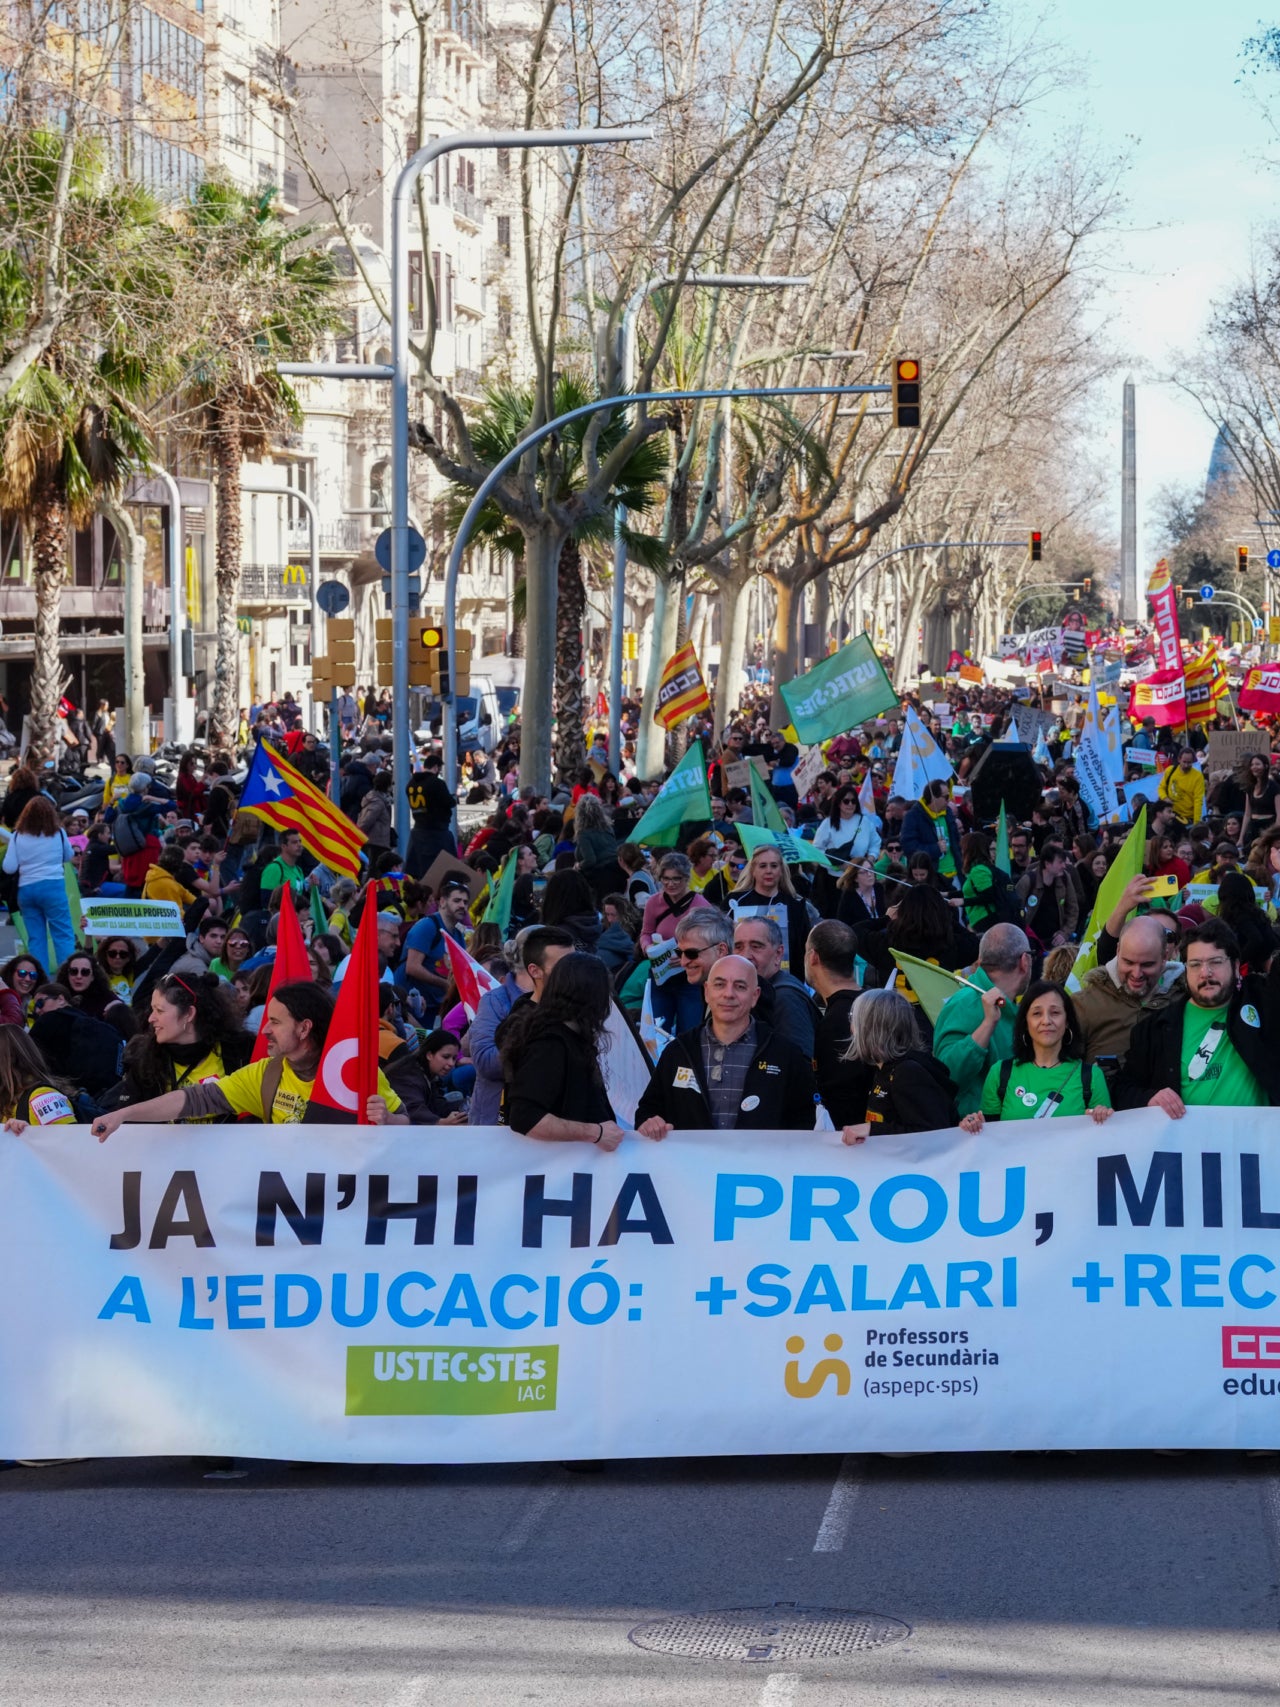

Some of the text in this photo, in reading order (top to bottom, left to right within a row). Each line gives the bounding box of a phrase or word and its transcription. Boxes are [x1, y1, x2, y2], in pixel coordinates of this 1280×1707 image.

[90, 906, 178, 919] DIGNIFIQUEM LA PROFESSIÓ
[278, 1091, 295, 1101] VAGA
[37, 1104, 53, 1117] DEL
[109, 1171, 216, 1250] JA
[522, 1172, 674, 1248] HA
[714, 1165, 1054, 1247] PROU,
[97, 1275, 152, 1324] A
[695, 1257, 1018, 1317] +SALARI
[866, 1328, 969, 1346] Professors
[373, 1351, 547, 1383] USTEC·STEs
[865, 1347, 1000, 1368] de Secundària
[517, 1385, 546, 1401] IAC
[863, 1375, 979, 1398] (aspepc·sps)
